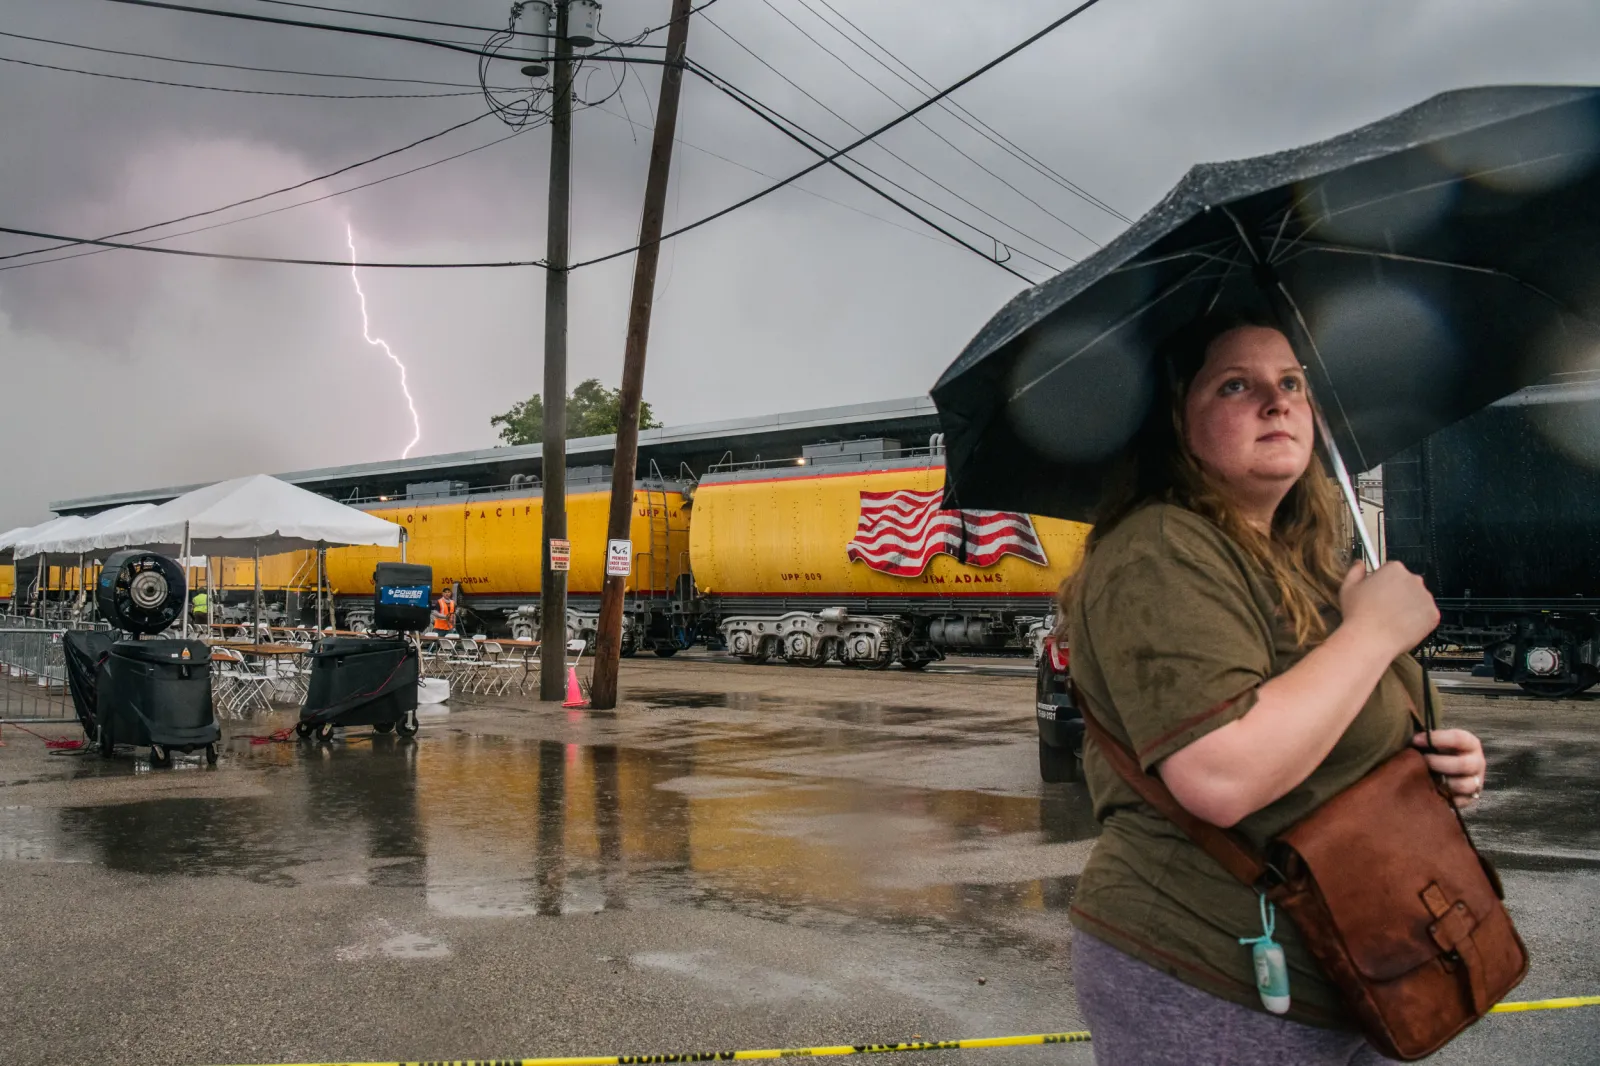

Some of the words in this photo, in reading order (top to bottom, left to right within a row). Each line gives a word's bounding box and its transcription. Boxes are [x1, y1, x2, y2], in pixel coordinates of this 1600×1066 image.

[460, 576, 488, 584] JORDAN
[781, 573, 799, 581] UPP
[804, 572, 822, 581] 809
[922, 575, 945, 584] JIM
[955, 573, 1003, 583] ADAMS
